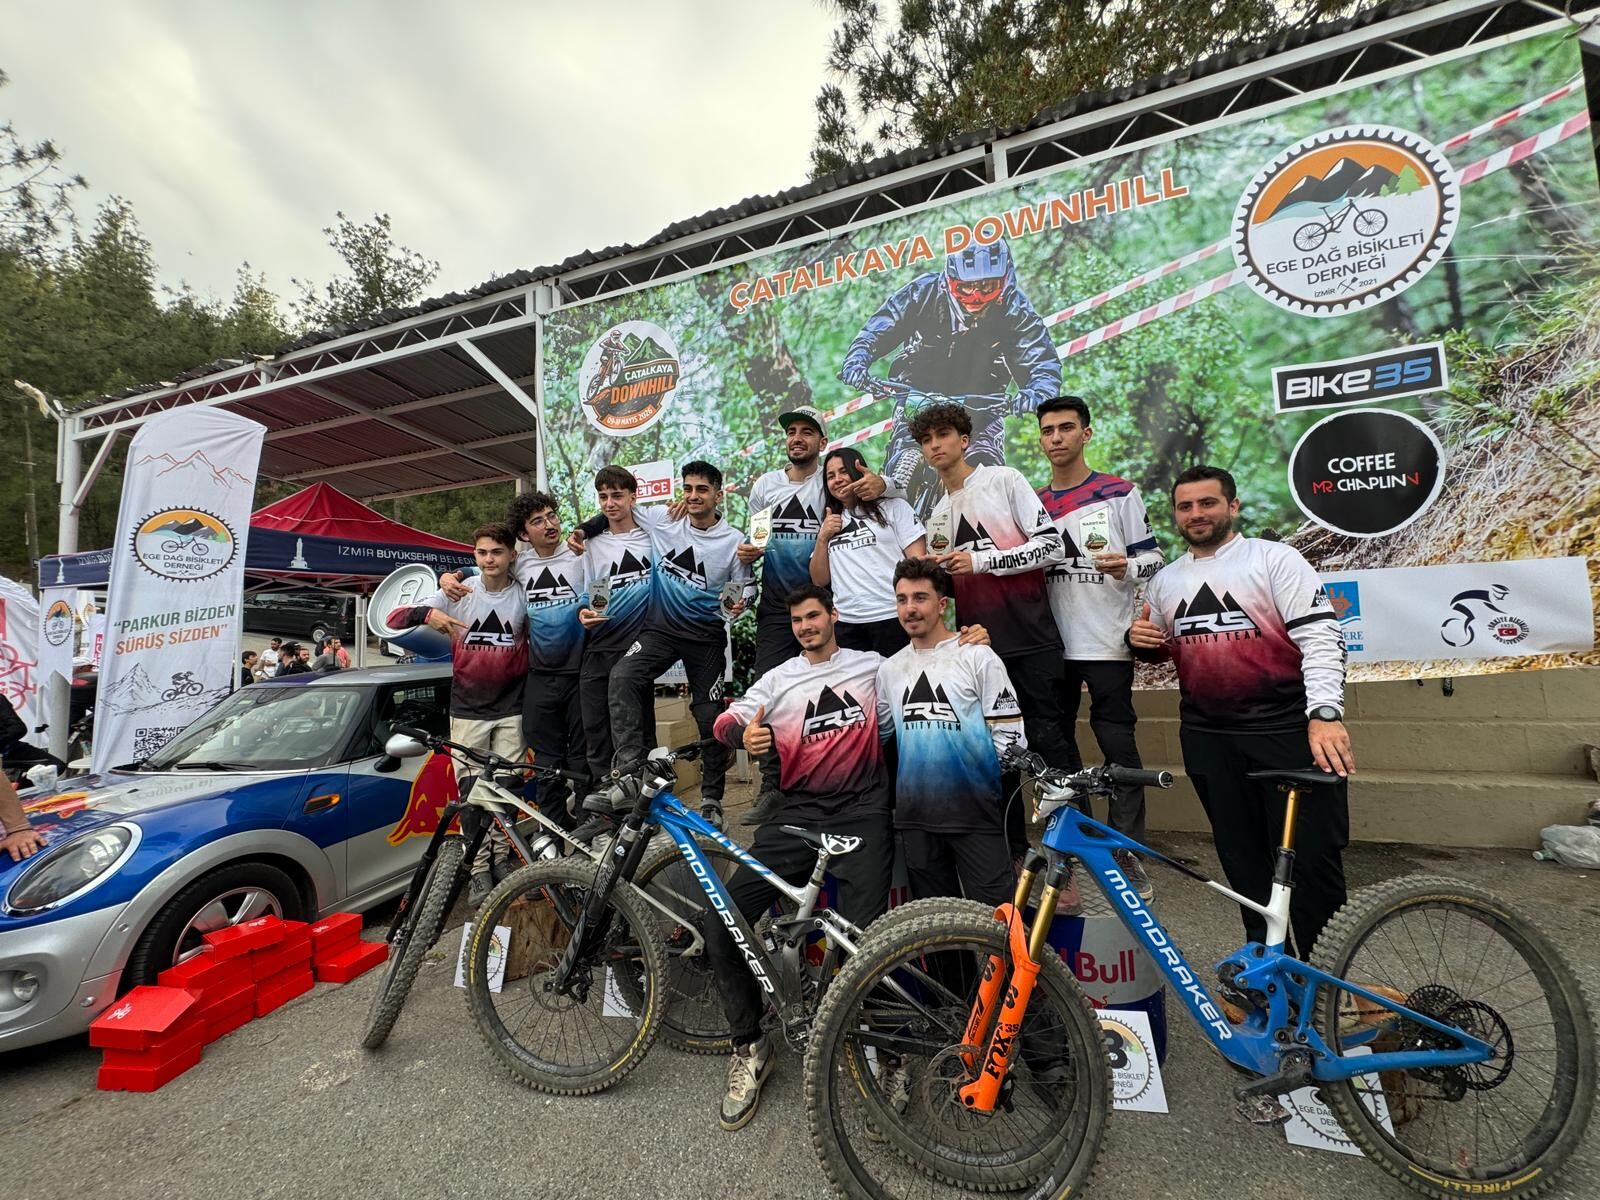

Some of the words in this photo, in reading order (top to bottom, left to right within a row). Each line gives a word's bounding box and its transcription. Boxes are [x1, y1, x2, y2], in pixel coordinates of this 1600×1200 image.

[729, 232, 935, 315] ÇATALKAYA
[943, 167, 1189, 255] DOWNHILL
[1266, 260, 1298, 275] EGE
[1302, 246, 1341, 270] DAĞ
[1346, 228, 1425, 258] BİSİKLETİ
[1307, 254, 1387, 285] DERNEĞİ
[1314, 287, 1336, 298] İZMİR
[1359, 278, 1378, 288] 2021
[624, 364, 674, 384] ÇATALKAYA
[610, 375, 675, 405] DOWNHILL
[1327, 452, 1396, 474] COFFEE
[1312, 480, 1337, 494] MR.
[338, 545, 374, 558] İZMİR
[526, 586, 576, 600] FRS
[184, 604, 235, 624] BİZDEN
[1174, 611, 1257, 637] FRS
[115, 633, 165, 656] SÜRÜŞ
[464, 632, 516, 647] FRS
[1226, 630, 1262, 641] TEAM
[802, 705, 866, 737] FRS
[902, 702, 958, 722] FRS
[937, 721, 961, 731] TEAM
[678, 843, 775, 994] MONDRAKER
[469, 910, 493, 969] SCORPION
[1075, 949, 1136, 983] Bull
[1104, 869, 1233, 1041] MONDRAKER
[985, 1022, 1011, 1080] FOX
[1299, 1104, 1316, 1114] EGE
[1443, 1179, 1513, 1194] PIRELLI
